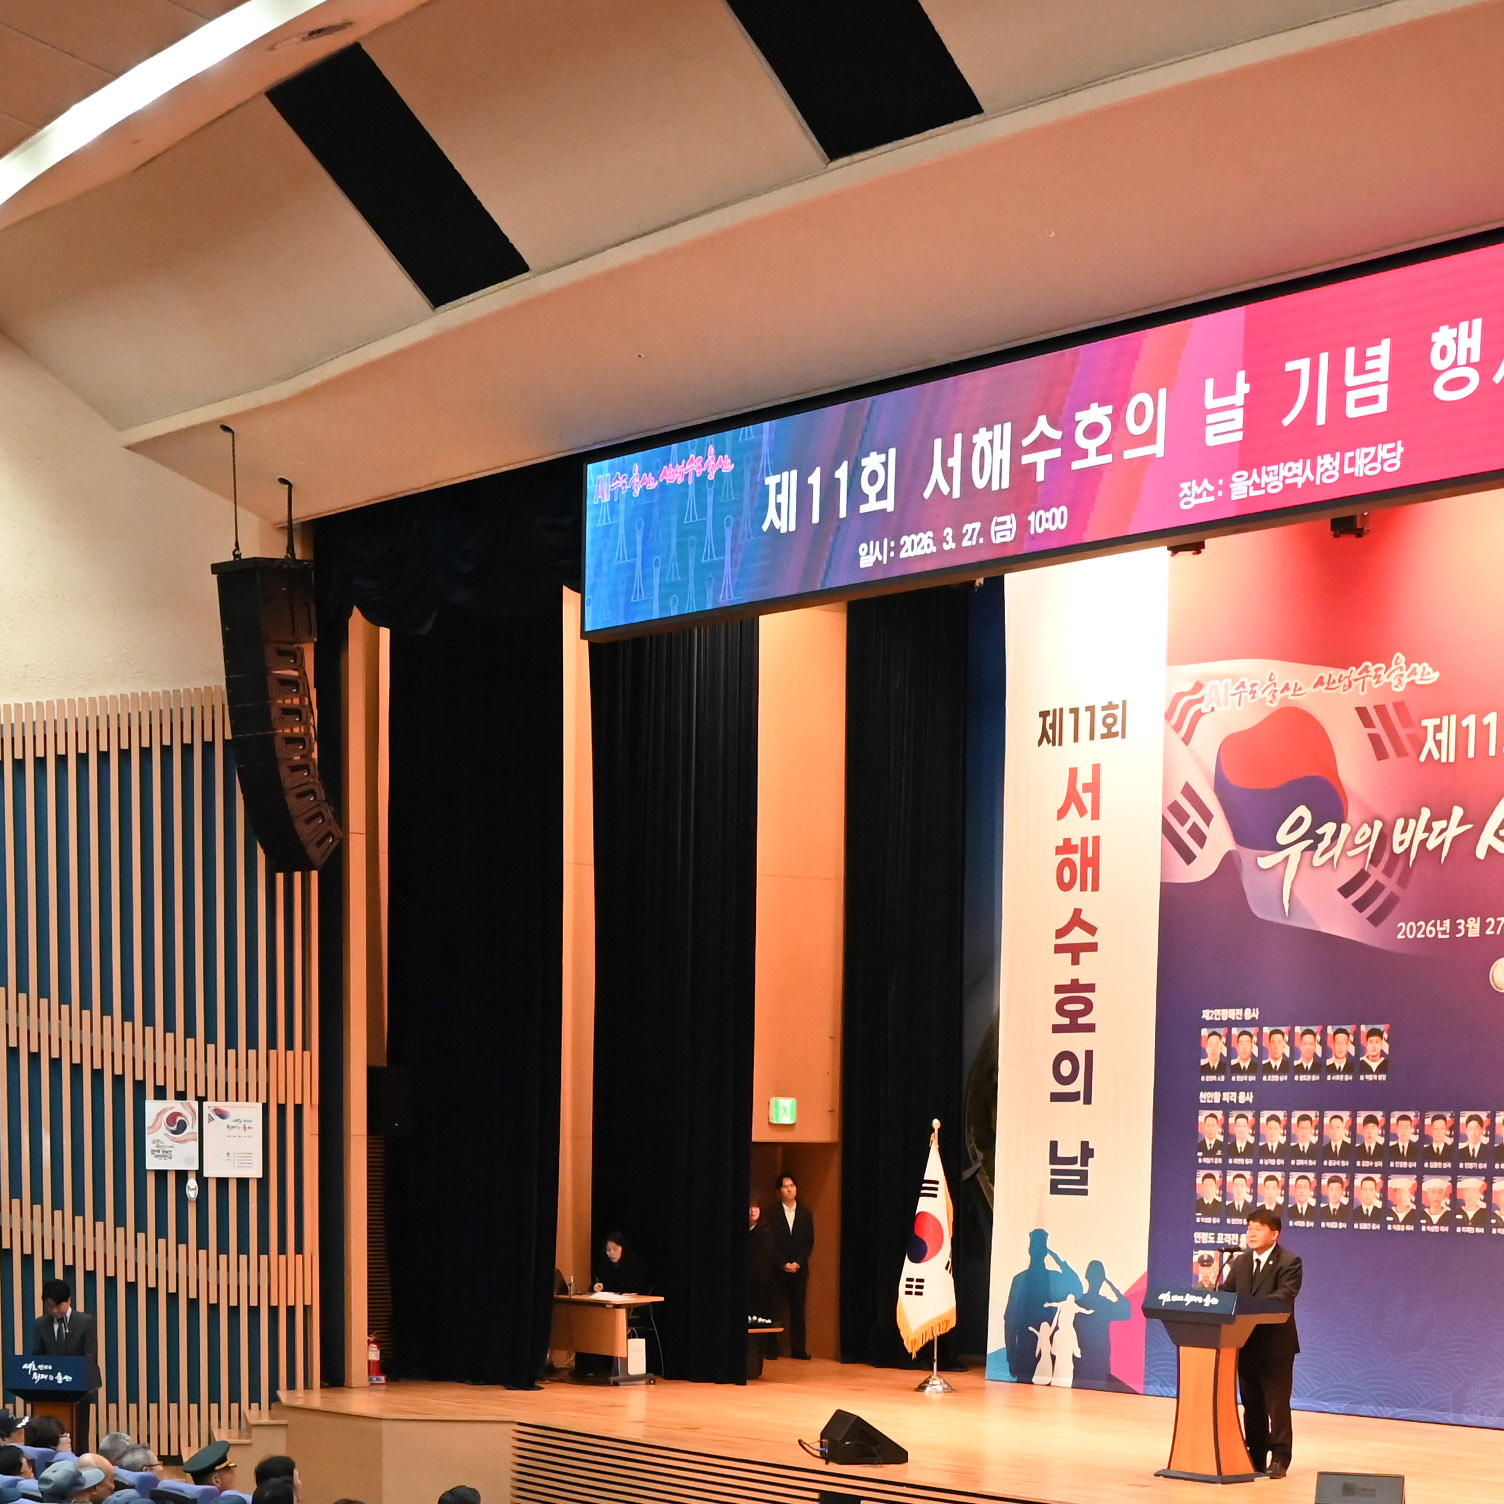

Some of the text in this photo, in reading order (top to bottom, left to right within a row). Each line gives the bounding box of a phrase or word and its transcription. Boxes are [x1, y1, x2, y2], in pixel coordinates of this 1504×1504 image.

[761, 447, 897, 536] 제11회
[922, 388, 1168, 500] 서해수호의
[1203, 370, 1250, 447] 날
[1281, 338, 1392, 428] 기념
[1229, 451, 1340, 501] 울산광역시청
[1343, 439, 1404, 478] 대강당
[899, 531, 937, 558] 2026.
[942, 527, 956, 551] 3.
[962, 522, 984, 547] 27.
[990, 513, 1017, 544] (금)
[1027, 505, 1068, 535] 10:00
[1037, 699, 1129, 748] 제11회
[1256, 805, 1380, 916] 우리의
[1392, 806, 1475, 866] 바다
[1396, 919, 1451, 940] 2026년
[1455, 916, 1482, 939] 3월
[1048, 762, 1103, 1197] 서해수호의 날
